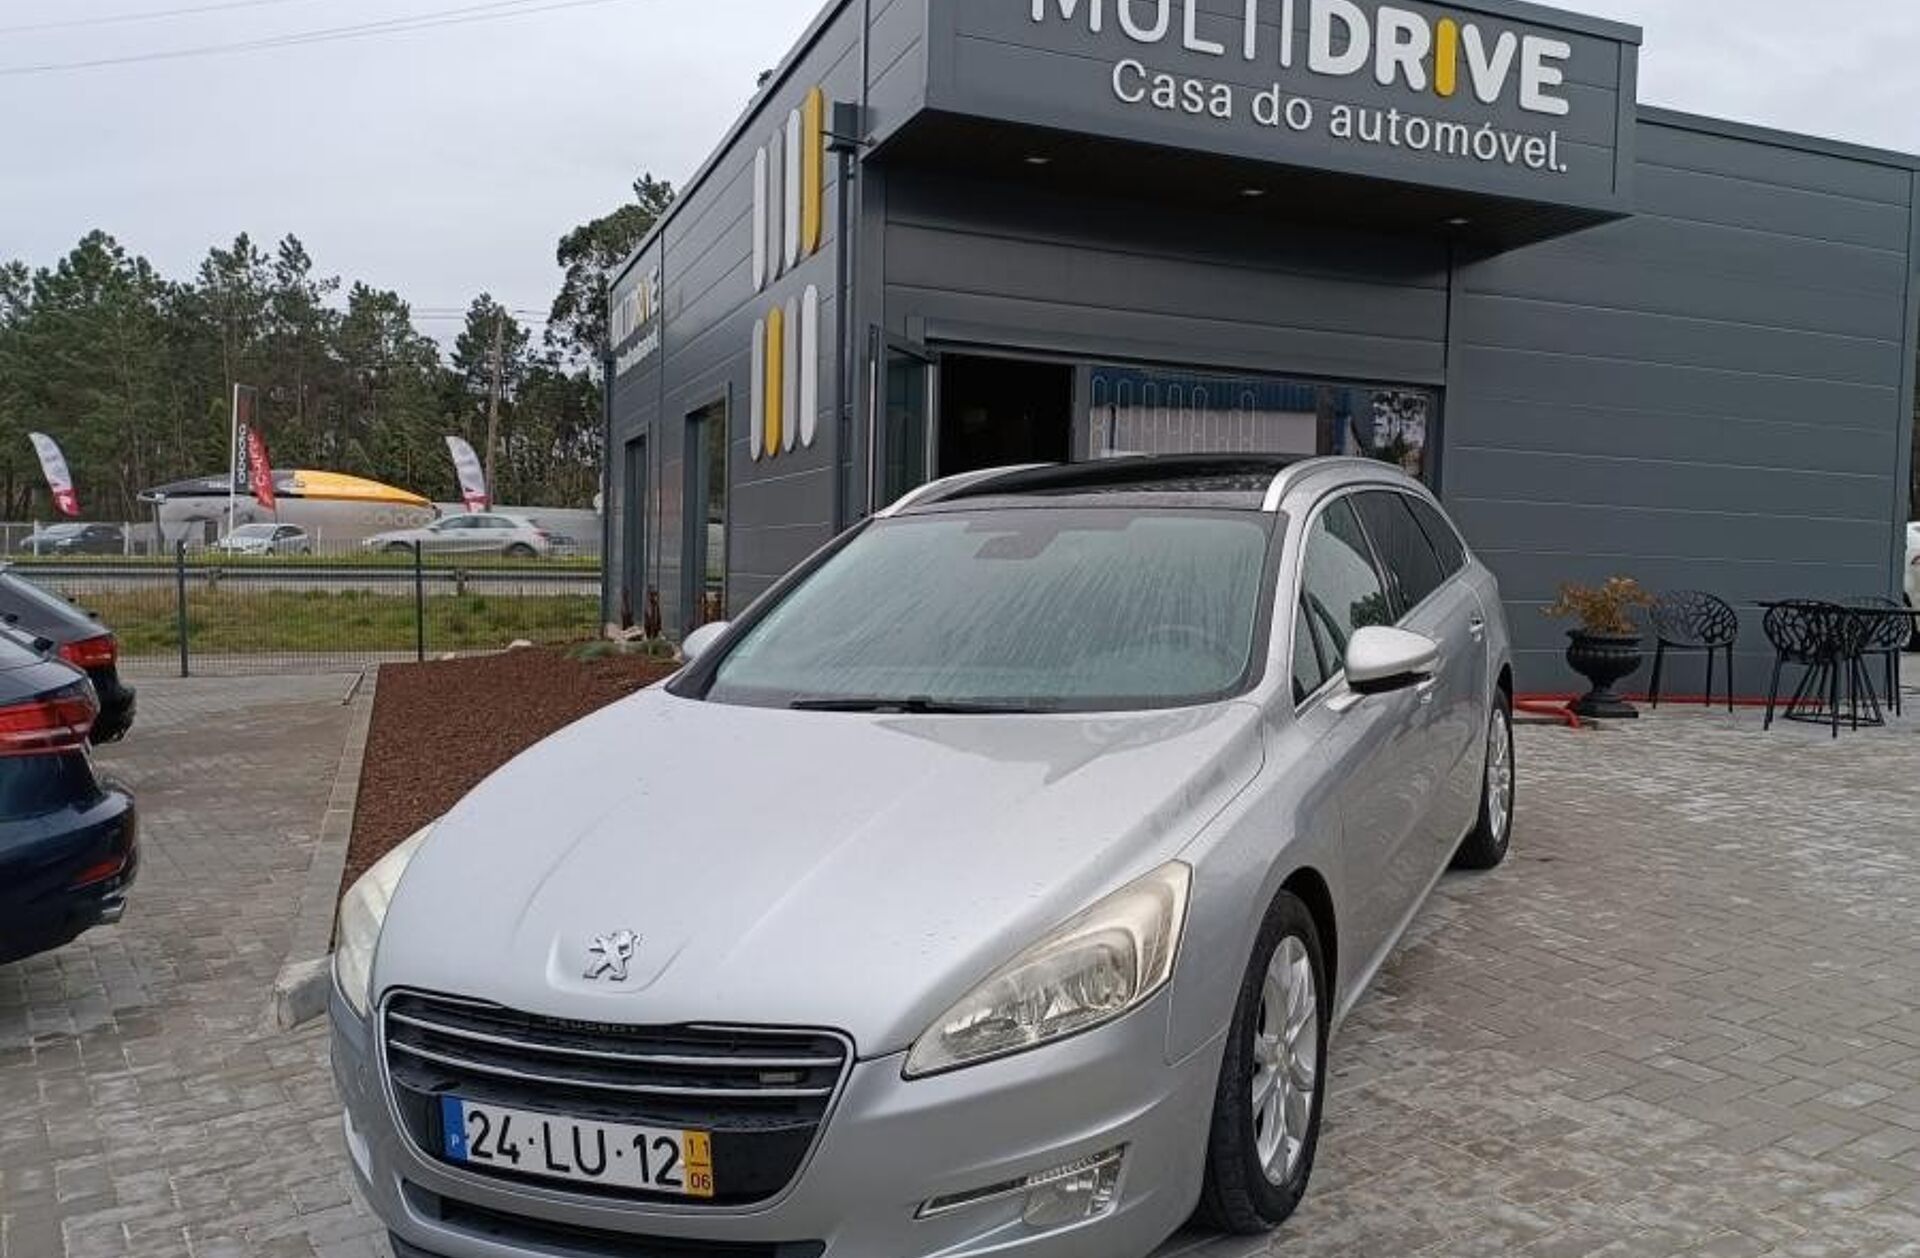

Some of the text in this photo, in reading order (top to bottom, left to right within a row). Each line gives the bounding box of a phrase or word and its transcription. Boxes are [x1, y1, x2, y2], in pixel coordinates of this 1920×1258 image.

[1112, 58, 1568, 173] Casa do automóvel.
[690, 1171, 712, 1191] 06
